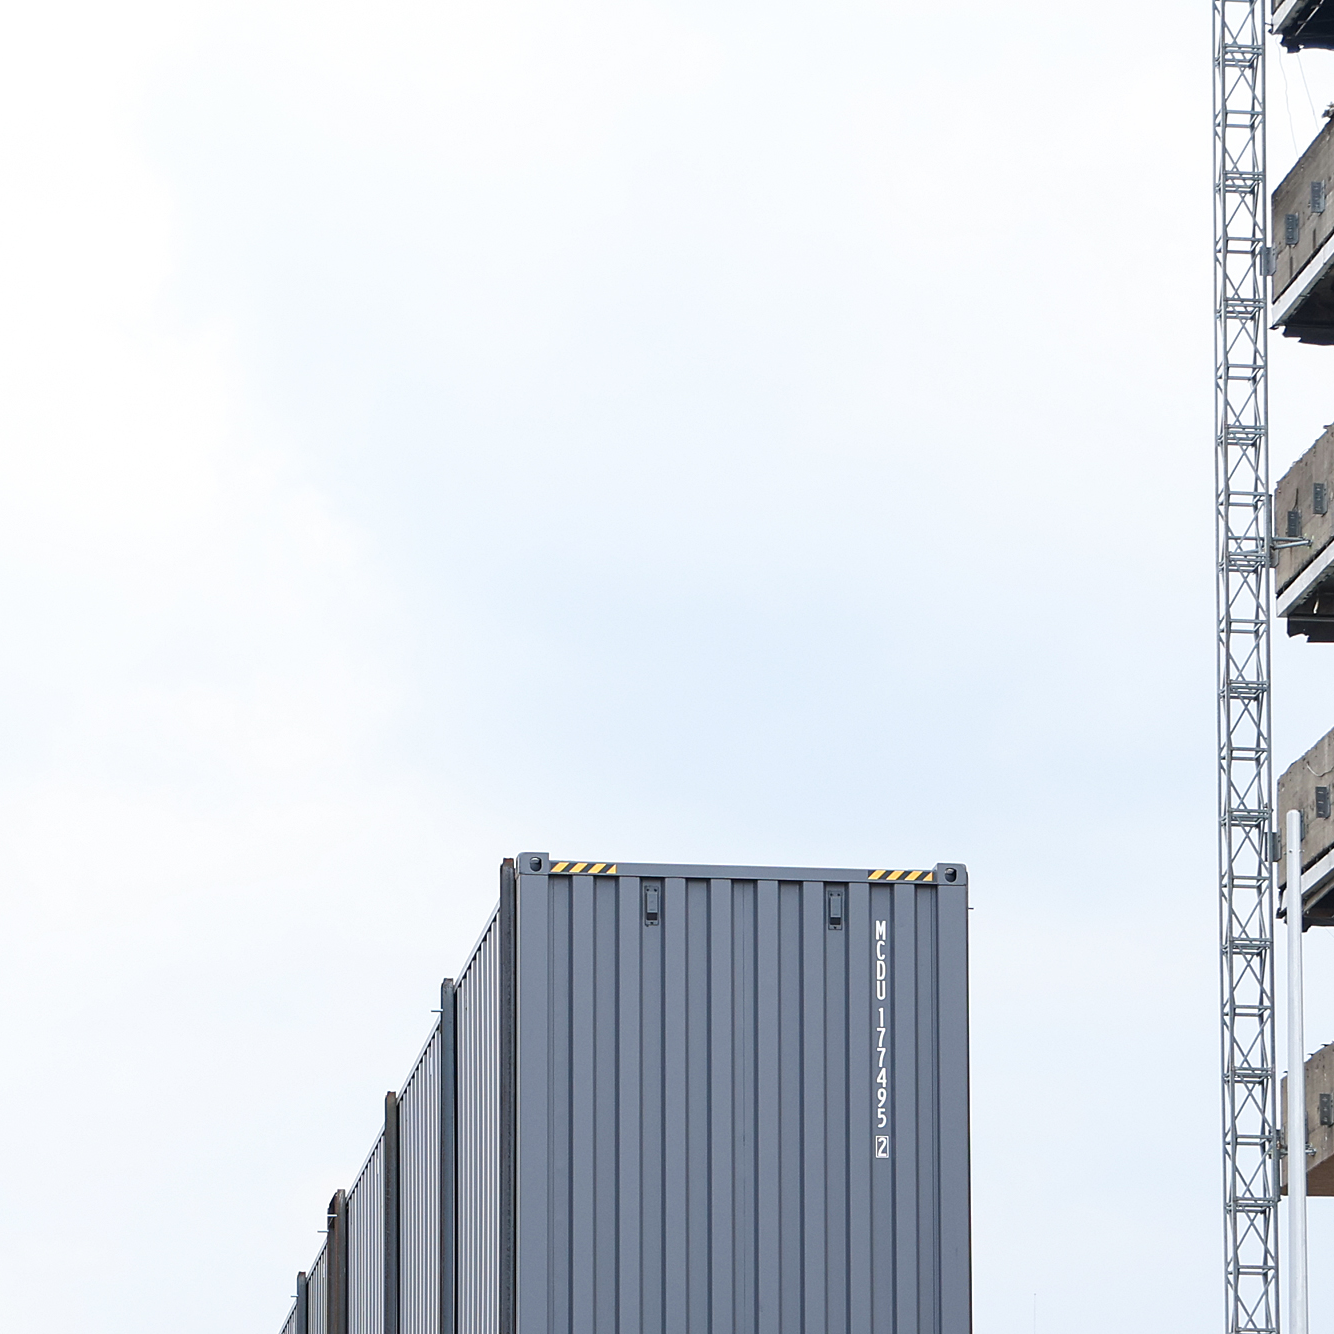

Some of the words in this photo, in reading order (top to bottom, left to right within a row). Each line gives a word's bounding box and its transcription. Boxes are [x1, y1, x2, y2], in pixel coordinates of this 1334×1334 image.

[875, 920, 887, 1001] MCDU
[876, 1007, 888, 1129] 177495
[877, 1137, 888, 1157] 2
